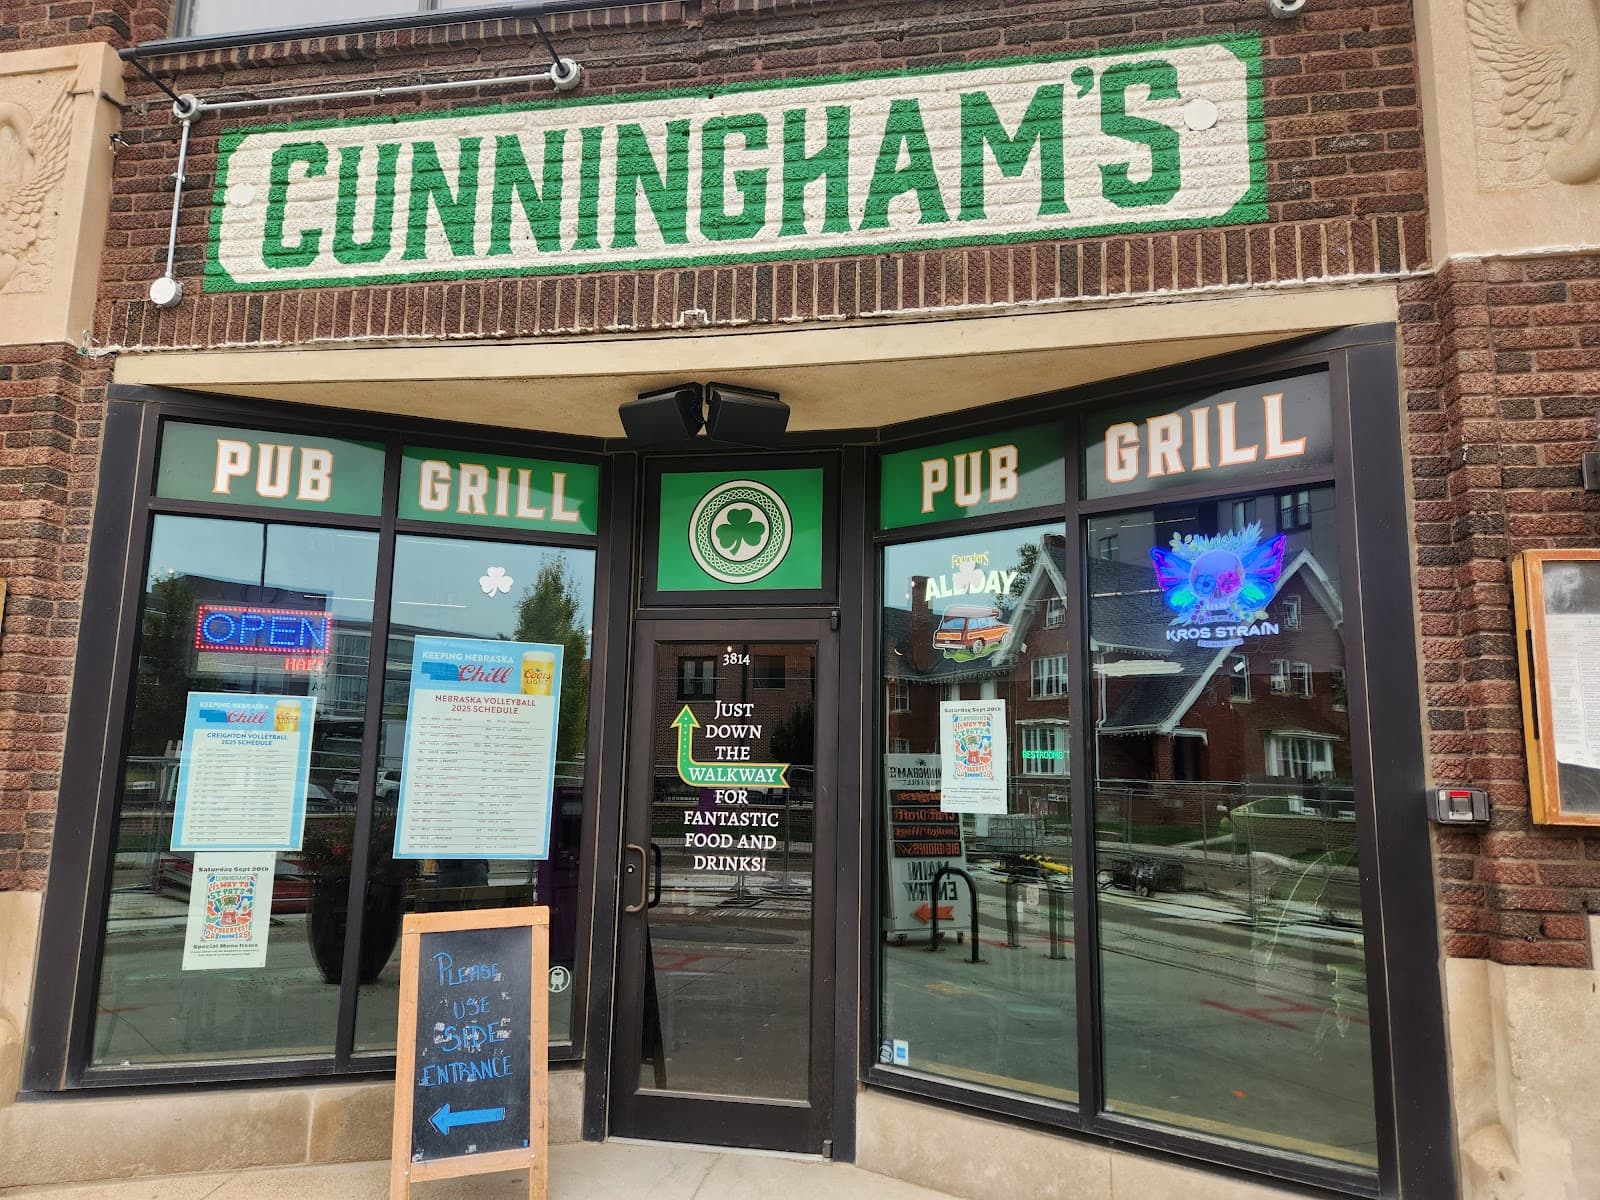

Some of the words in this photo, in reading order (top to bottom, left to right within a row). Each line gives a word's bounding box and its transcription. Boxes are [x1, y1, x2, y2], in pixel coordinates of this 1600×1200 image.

[263, 58, 1181, 269] CUNNINGHAM'S
[921, 444, 1019, 513] PUB
[1104, 393, 1307, 484] GRILL
[212, 438, 333, 501] PUB
[418, 460, 579, 522] GRILL
[202, 612, 326, 648] OPEN
[1166, 628, 1211, 642] KROS
[1215, 621, 1279, 638] STRAIN
[421, 651, 462, 661] KEEPING
[464, 654, 514, 664] NEBRASKA
[722, 653, 751, 665] 3814
[458, 664, 513, 684] Chill
[523, 669, 552, 681] Coors
[435, 694, 482, 704] NEBRASKA
[484, 697, 536, 707] VOLLEYBALL
[227, 710, 268, 724] Chill
[451, 704, 472, 712] 2025
[473, 706, 519, 715] SCHEDULE
[714, 700, 755, 720] JUST
[207, 732, 246, 740] CREIGHTON
[705, 724, 762, 739] DOWN
[715, 746, 750, 760] THE
[1022, 750, 1064, 760] RESTROOMS
[688, 767, 778, 782] WALKWAY
[714, 789, 749, 804] FOR
[683, 810, 780, 827] FANTASTIC
[684, 833, 733, 848] FOOD
[737, 834, 777, 849] AND
[693, 855, 767, 872] DRINKS!
[433, 952, 501, 986] PLEASE
[453, 996, 490, 1019] USE
[442, 1022, 505, 1052] SIDE
[420, 1056, 513, 1086] ENTRANCE
